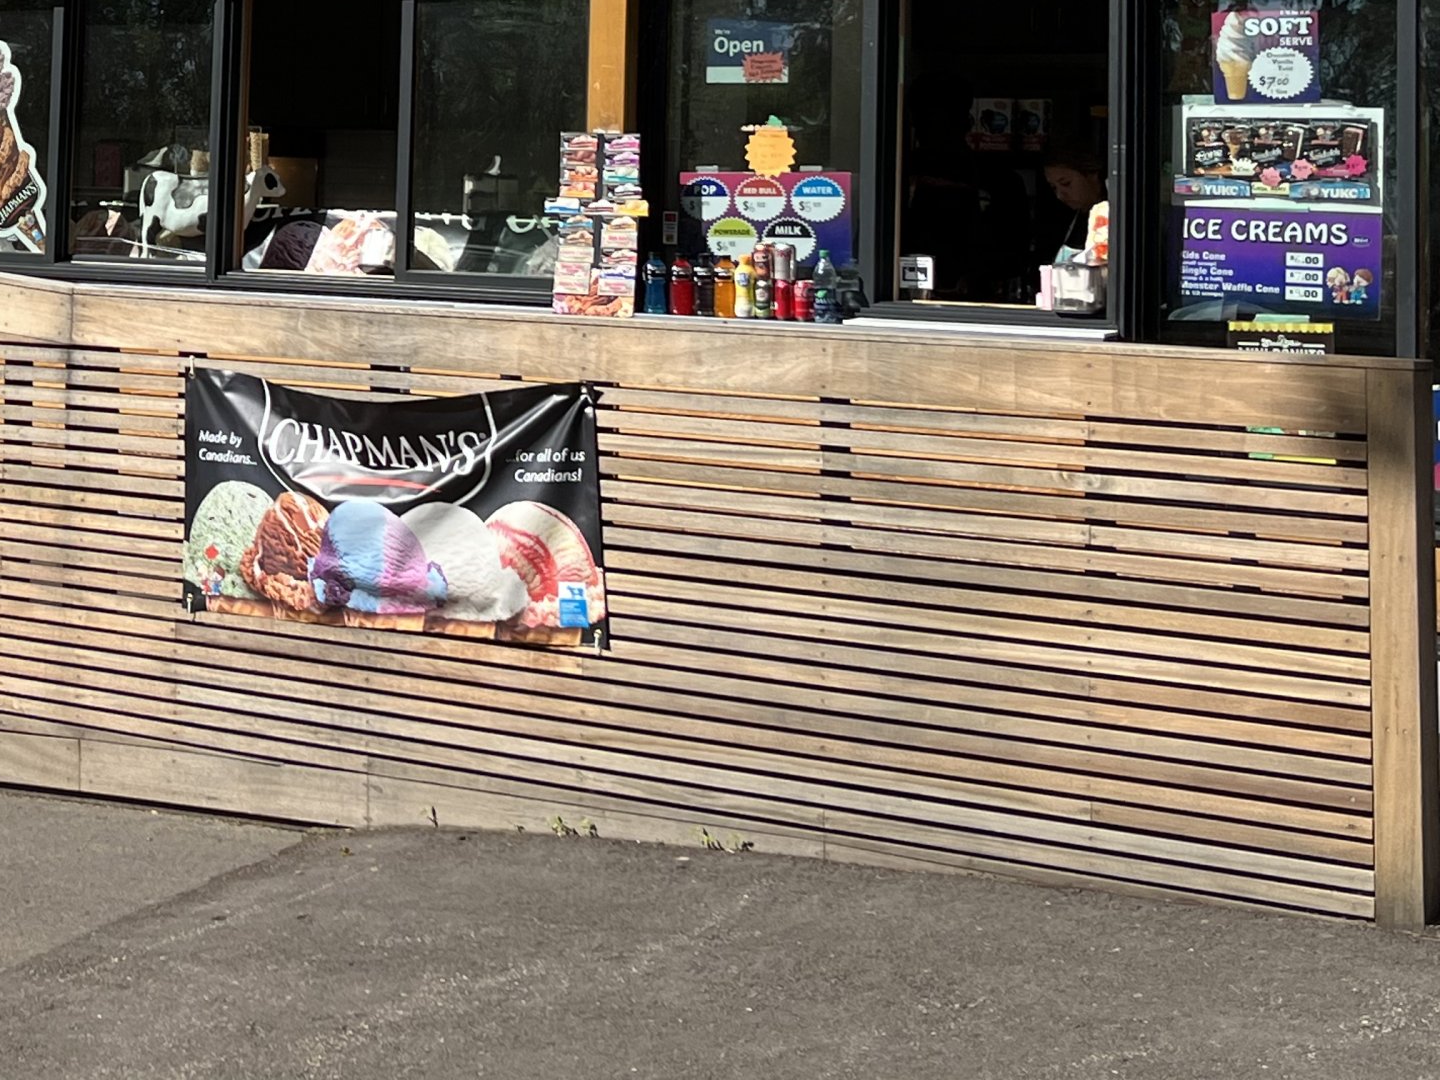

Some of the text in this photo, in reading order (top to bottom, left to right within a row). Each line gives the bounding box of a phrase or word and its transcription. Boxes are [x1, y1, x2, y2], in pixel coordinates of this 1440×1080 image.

[1244, 17, 1313, 36] SOFT
[714, 37, 764, 57] Open
[1280, 37, 1313, 46] SERVE
[694, 185, 717, 195] POP
[743, 186, 776, 195] RED BULL
[802, 186, 833, 195] WATER
[775, 225, 802, 235] MILK
[1182, 218, 1348, 246] ICE CREAMS
[1202, 251, 1226, 260] Cone
[1210, 267, 1234, 276] Cone
[1222, 282, 1253, 292] Waffle
[1255, 284, 1280, 294] Cone
[198, 429, 242, 448] Made by
[268, 417, 480, 476] CHAPMAN'S
[536, 448, 552, 462] all
[553, 448, 569, 462] of
[570, 451, 586, 462] us
[514, 468, 583, 482] Canadians!
